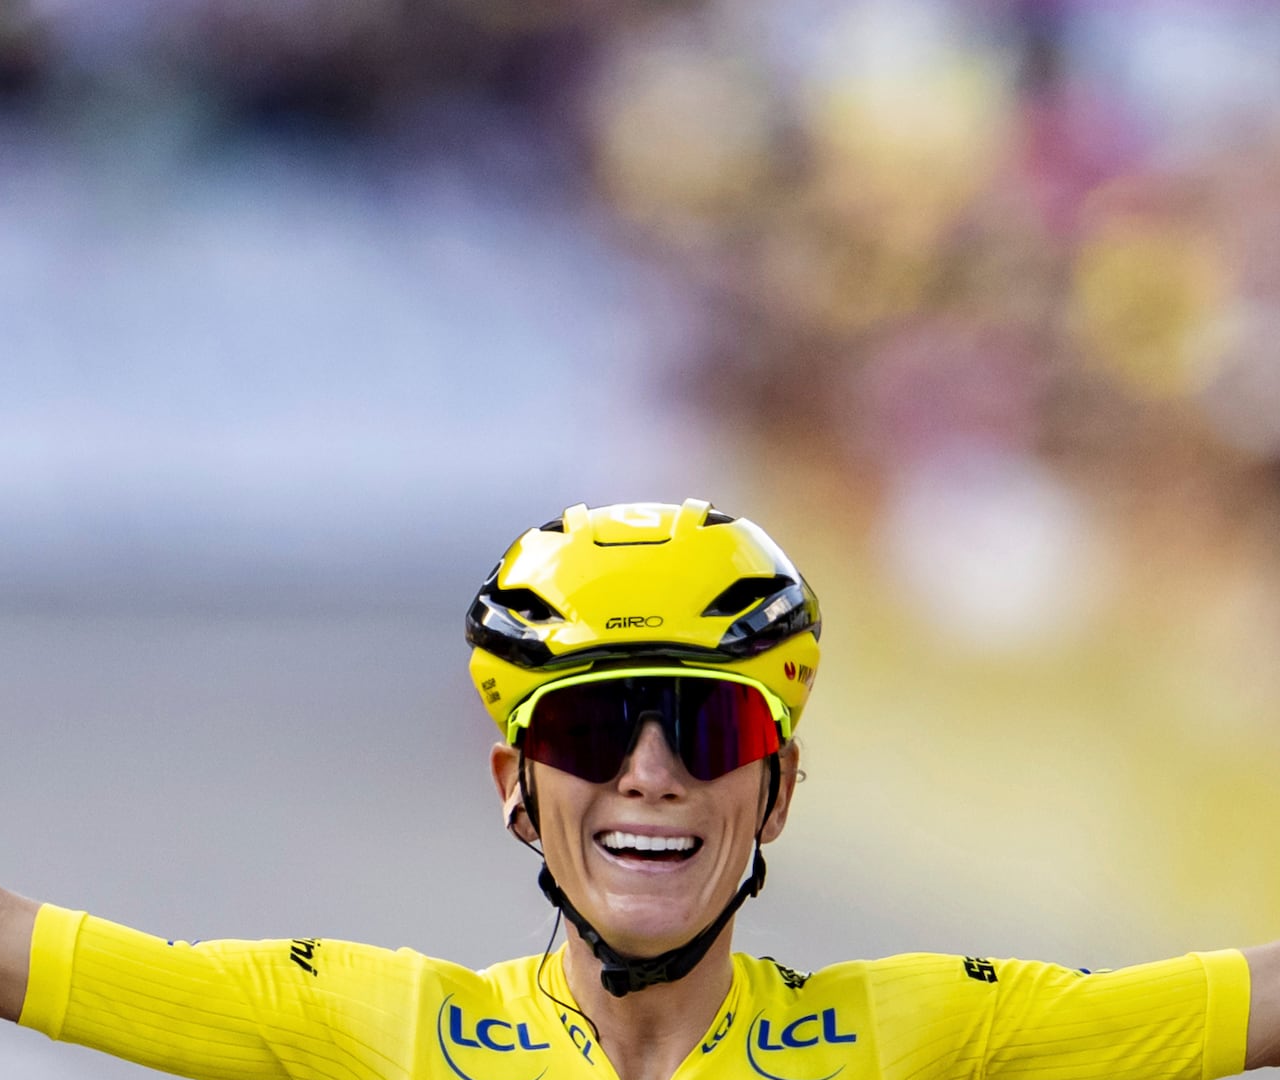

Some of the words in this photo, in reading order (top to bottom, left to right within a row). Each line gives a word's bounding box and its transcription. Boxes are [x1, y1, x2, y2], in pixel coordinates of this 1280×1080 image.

[606, 615, 664, 629] GIRO
[449, 1004, 550, 1052] LCL
[757, 1007, 857, 1051] LCL
